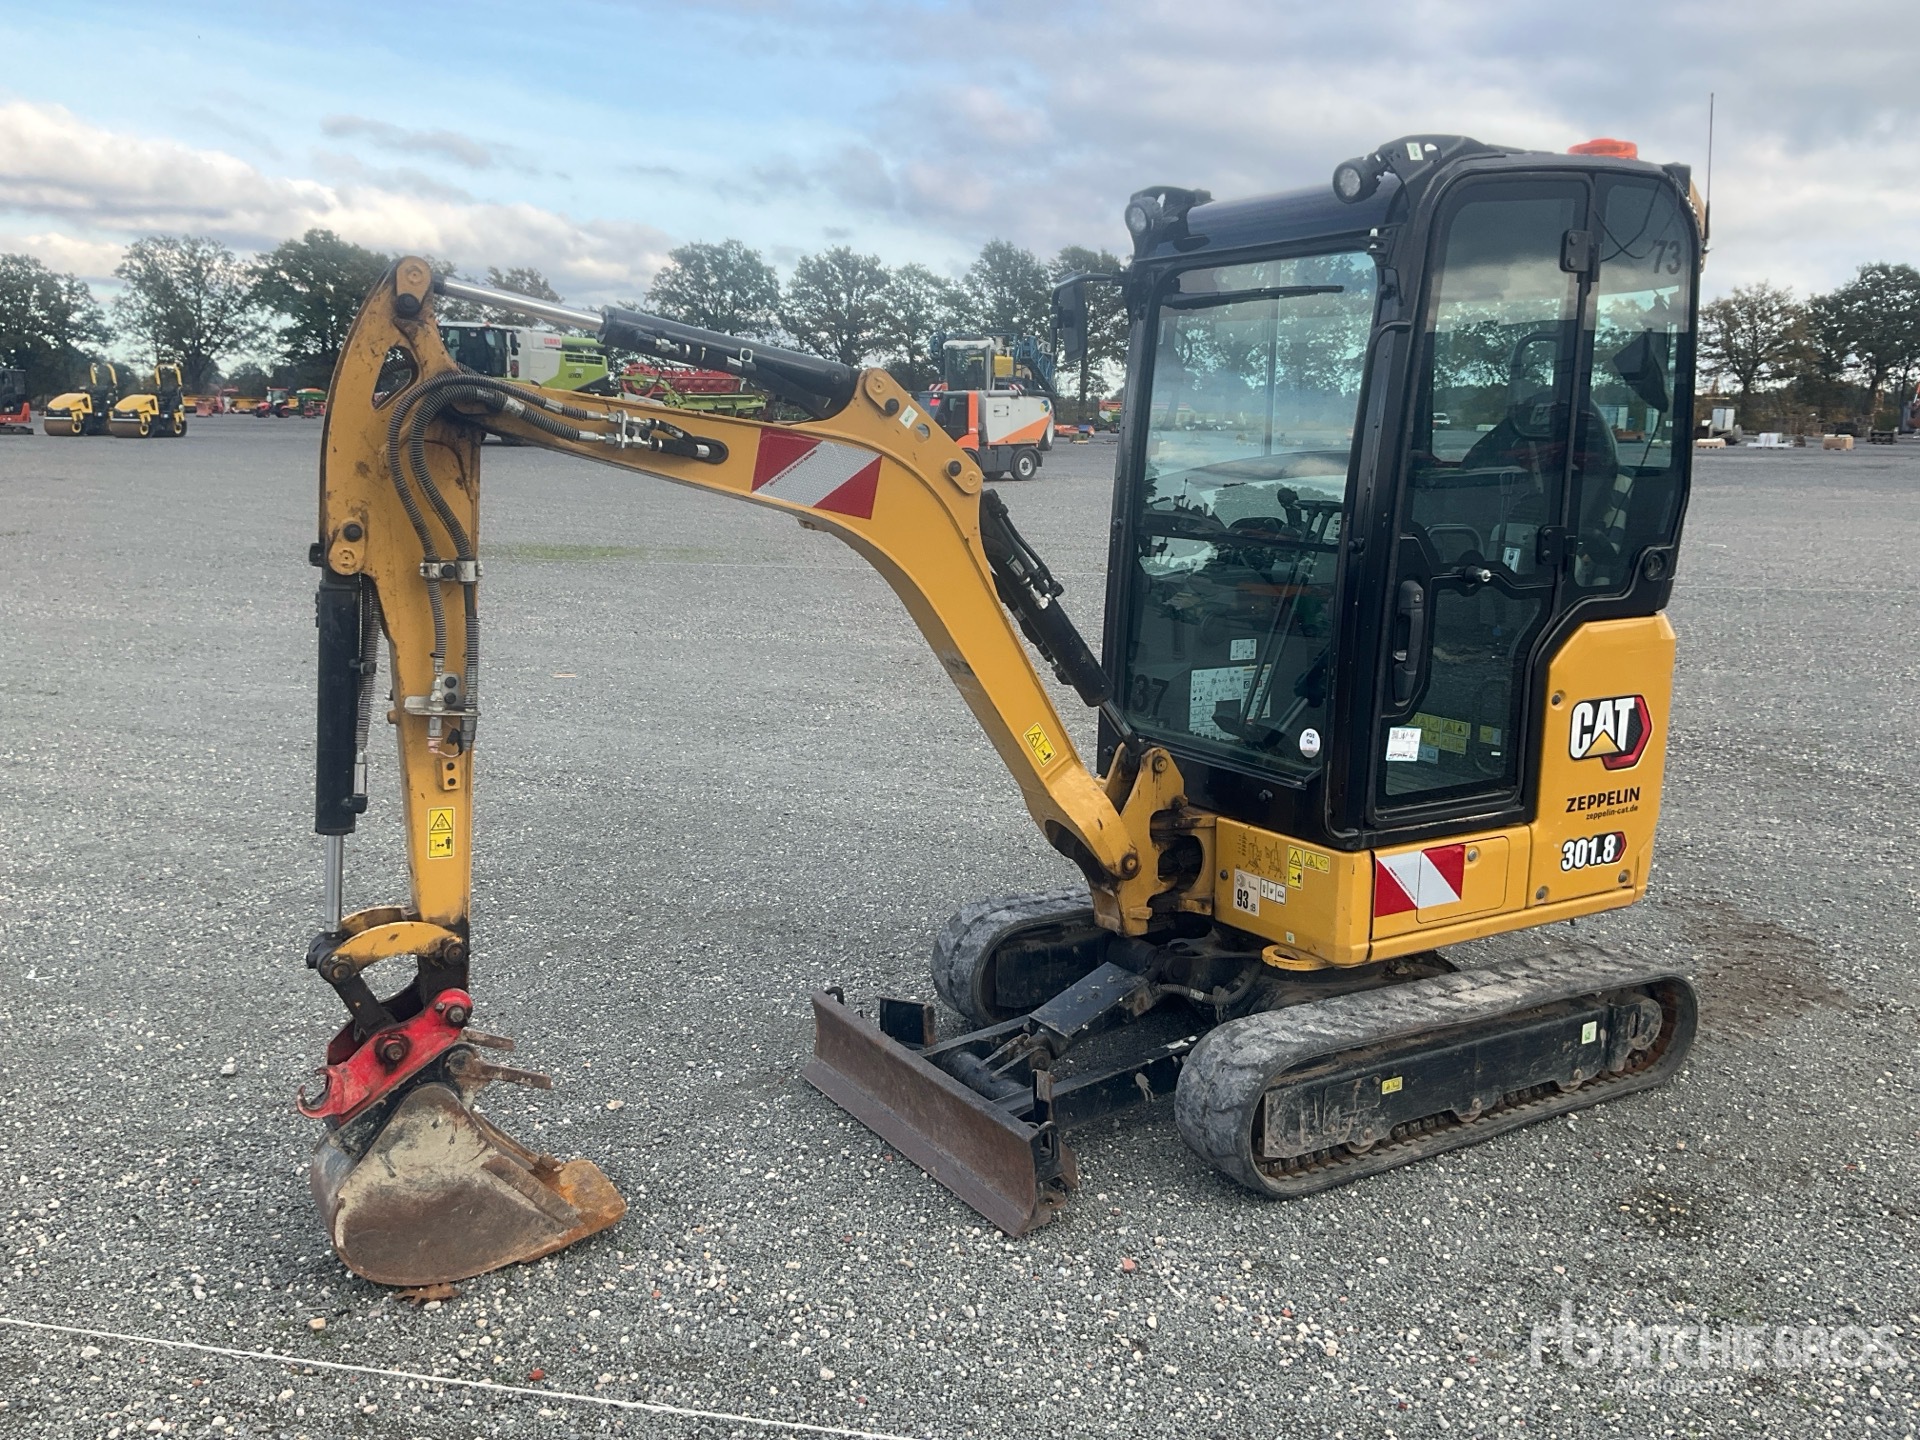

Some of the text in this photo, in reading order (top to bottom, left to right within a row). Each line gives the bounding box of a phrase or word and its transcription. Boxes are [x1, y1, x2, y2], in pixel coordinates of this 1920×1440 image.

[1652, 239, 1682, 275] 73
[1570, 697, 1635, 759] CAT
[1565, 786, 1641, 813] ZEPPELIN
[1585, 804, 1639, 821] zeppelin-cat.de
[1561, 834, 1617, 871] 301.8
[1236, 888, 1249, 909] 93
